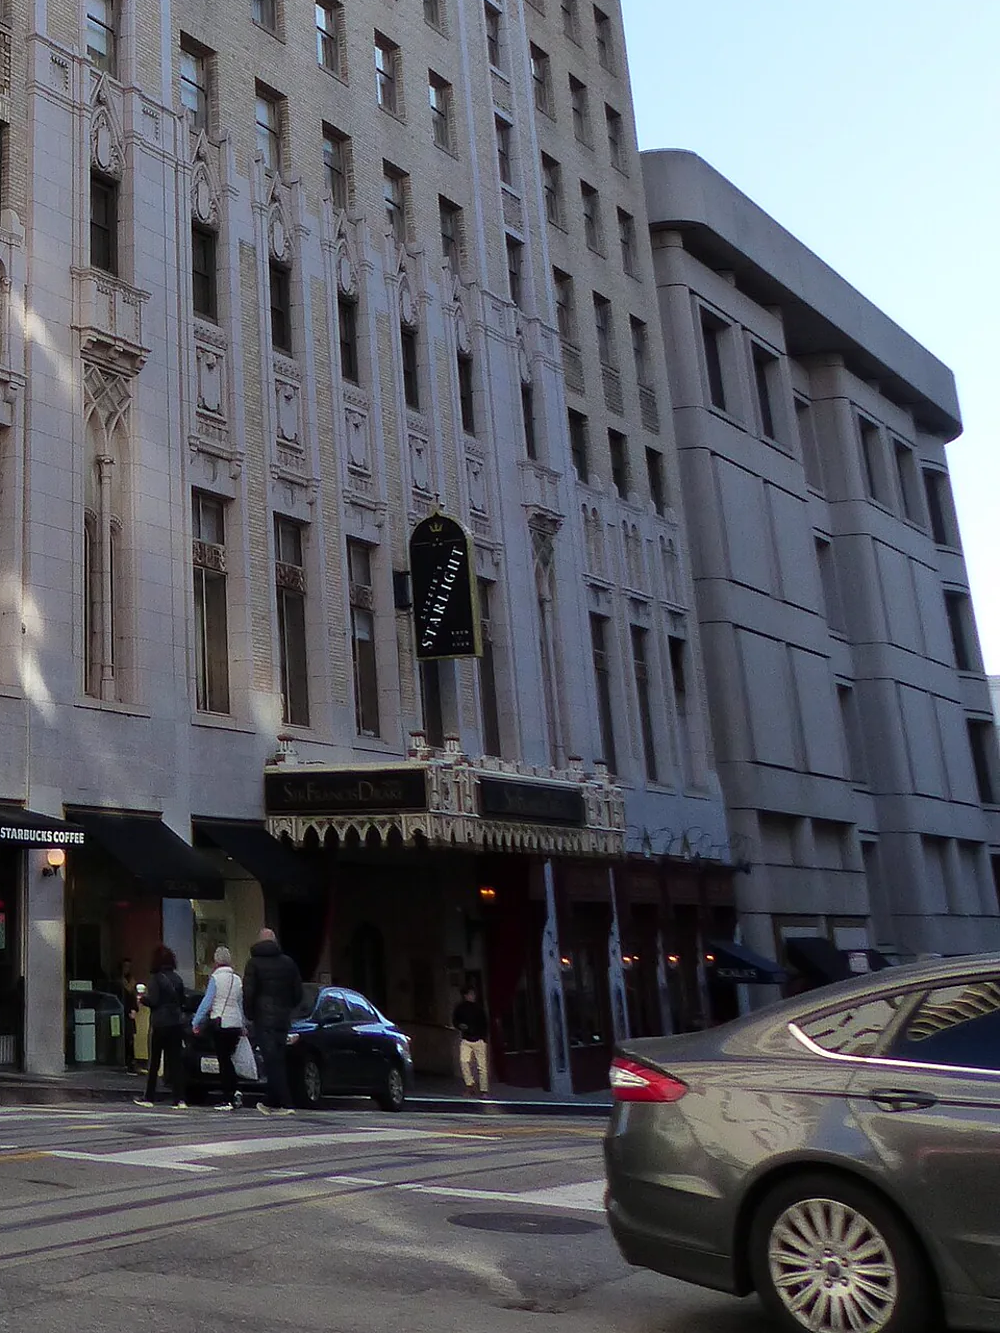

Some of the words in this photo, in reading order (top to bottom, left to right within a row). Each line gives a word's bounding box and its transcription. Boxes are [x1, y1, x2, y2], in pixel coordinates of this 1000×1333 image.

[421, 545, 464, 650] STARLIGHT
[0, 827, 53, 842] STARBUCKS
[53, 831, 85, 844] COFFEE
